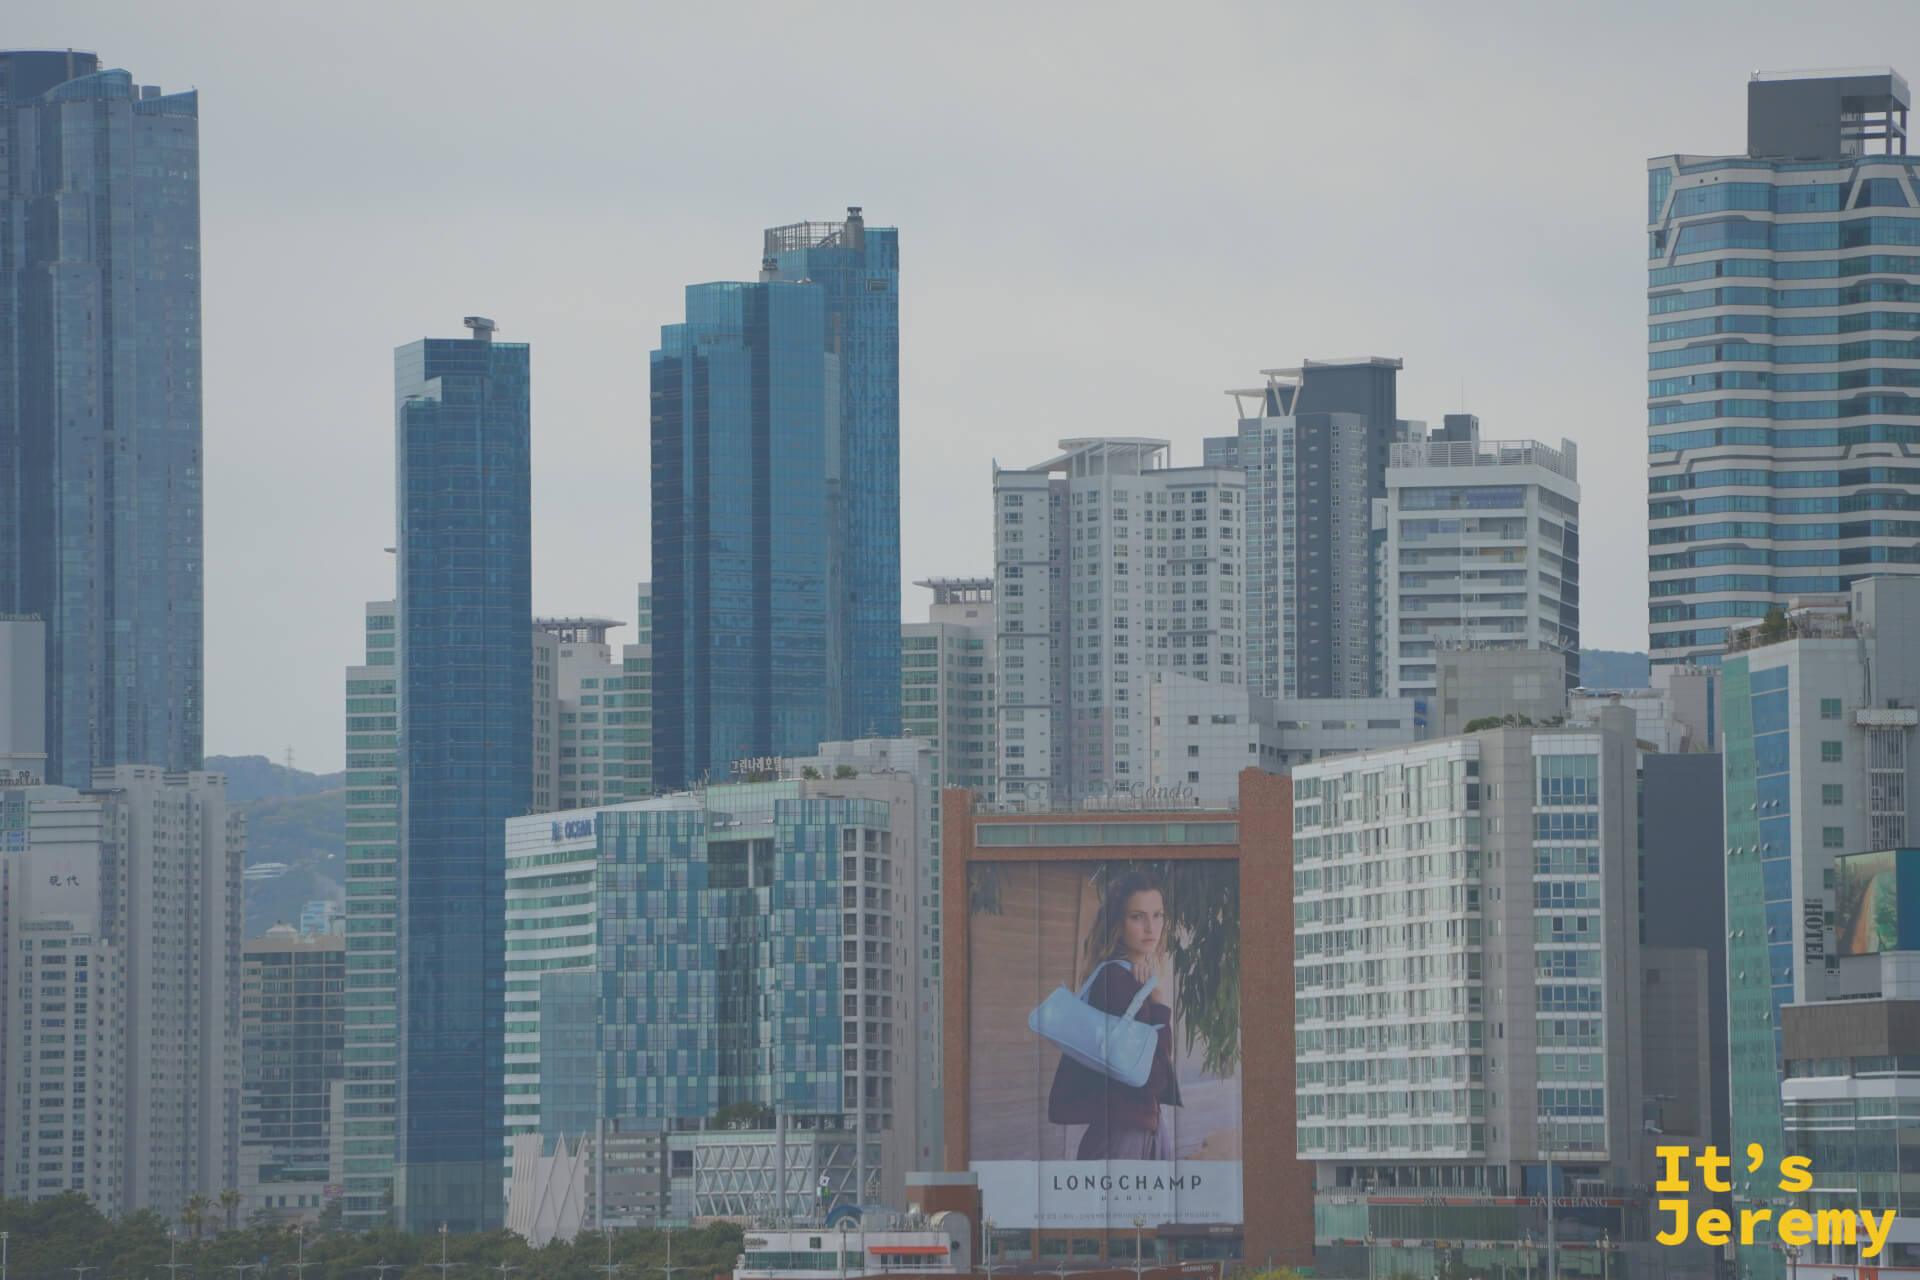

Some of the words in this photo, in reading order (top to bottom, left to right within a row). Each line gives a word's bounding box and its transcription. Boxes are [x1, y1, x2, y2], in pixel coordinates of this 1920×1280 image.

[1804, 903, 1824, 965] HOTEL
[1053, 1175, 1202, 1191] LONGCHAMP
[1571, 1196, 1608, 1208] BANG
